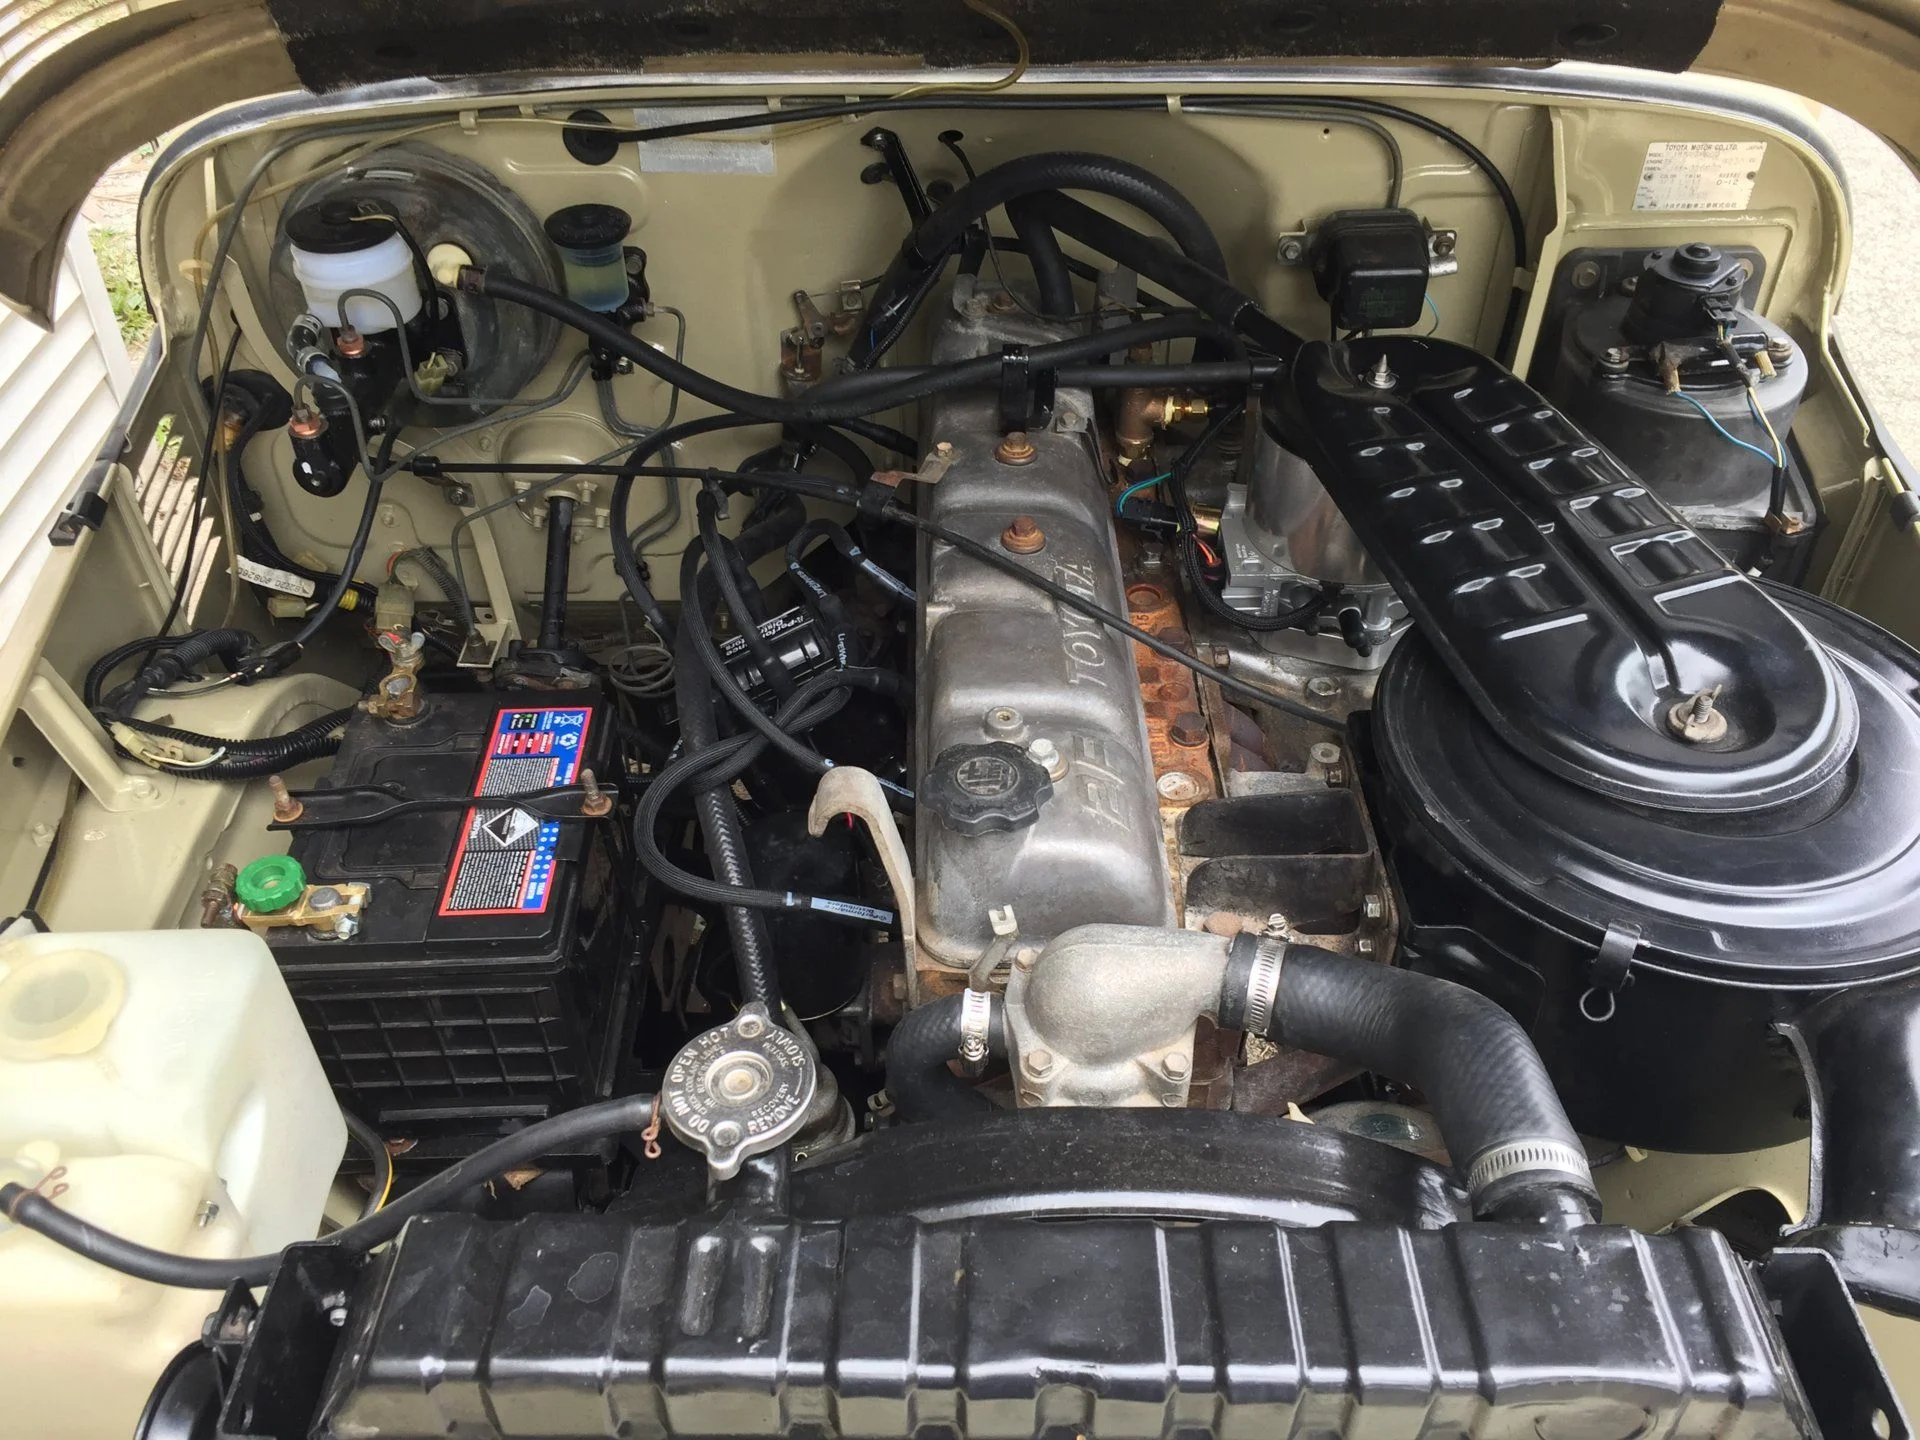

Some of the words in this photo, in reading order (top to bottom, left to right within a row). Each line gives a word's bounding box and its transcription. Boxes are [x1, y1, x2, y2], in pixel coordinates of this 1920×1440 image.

[699, 1027, 728, 1048] HOT
[765, 1030, 806, 1067] SLOWLY
[671, 1048, 699, 1082] OPEN
[762, 1041, 790, 1067] SYSTEM
[669, 1090, 691, 1116] NOT
[751, 1081, 790, 1117] RECOVERY
[688, 1114, 710, 1133] DO
[747, 1094, 801, 1135] REMOVE
